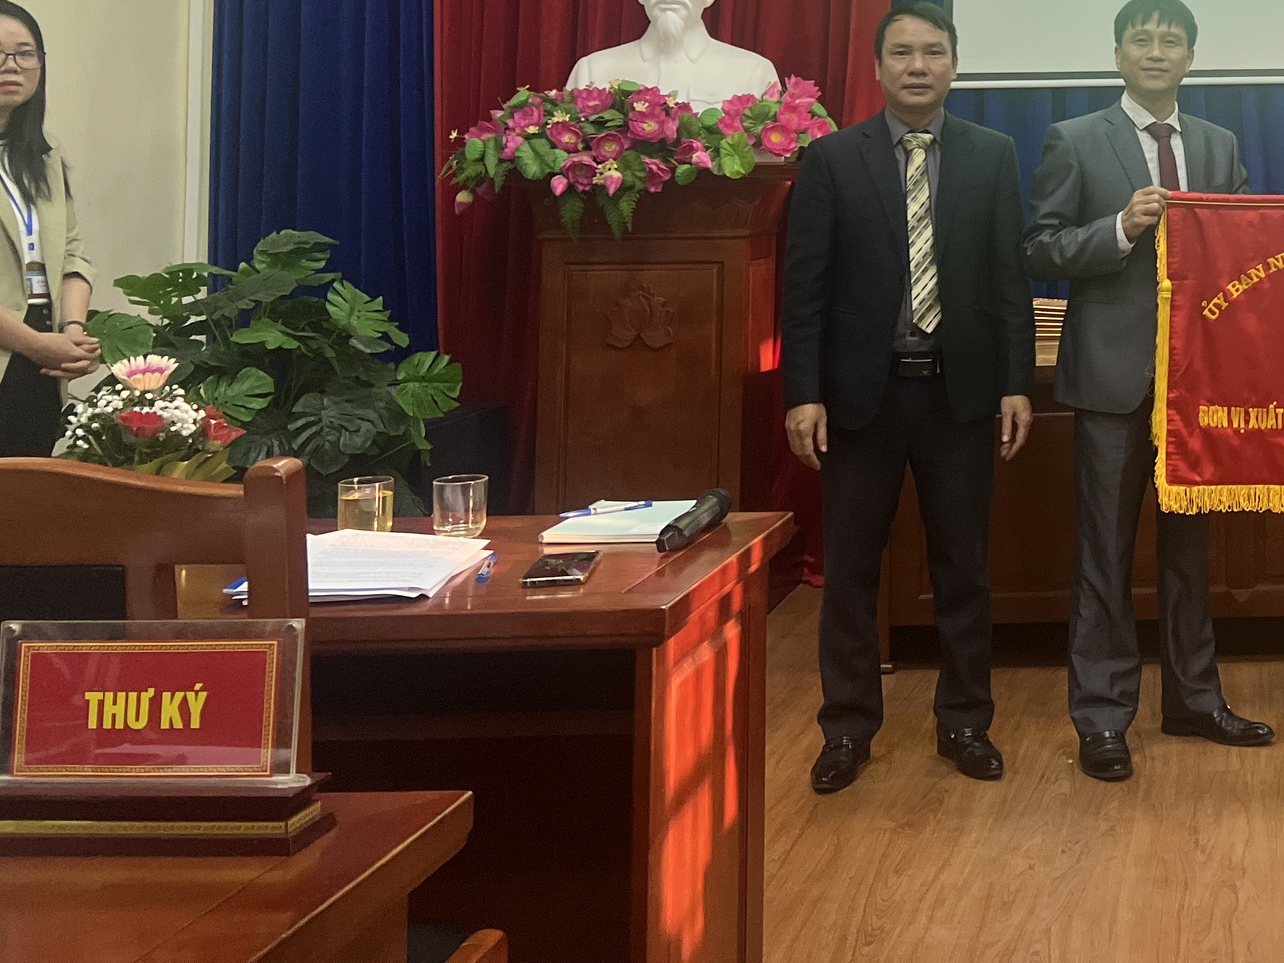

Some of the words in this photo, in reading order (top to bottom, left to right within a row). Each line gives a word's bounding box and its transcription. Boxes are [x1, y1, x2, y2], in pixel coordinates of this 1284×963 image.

[1201, 292, 1229, 321] ỦY
[1226, 263, 1266, 299] BAN
[1198, 404, 1229, 428] ĐƠN
[1230, 406, 1246, 434] VỊ
[1248, 400, 1284, 430] XUẤT
[84, 687, 155, 730] THƯ
[160, 682, 208, 730] KÝ
